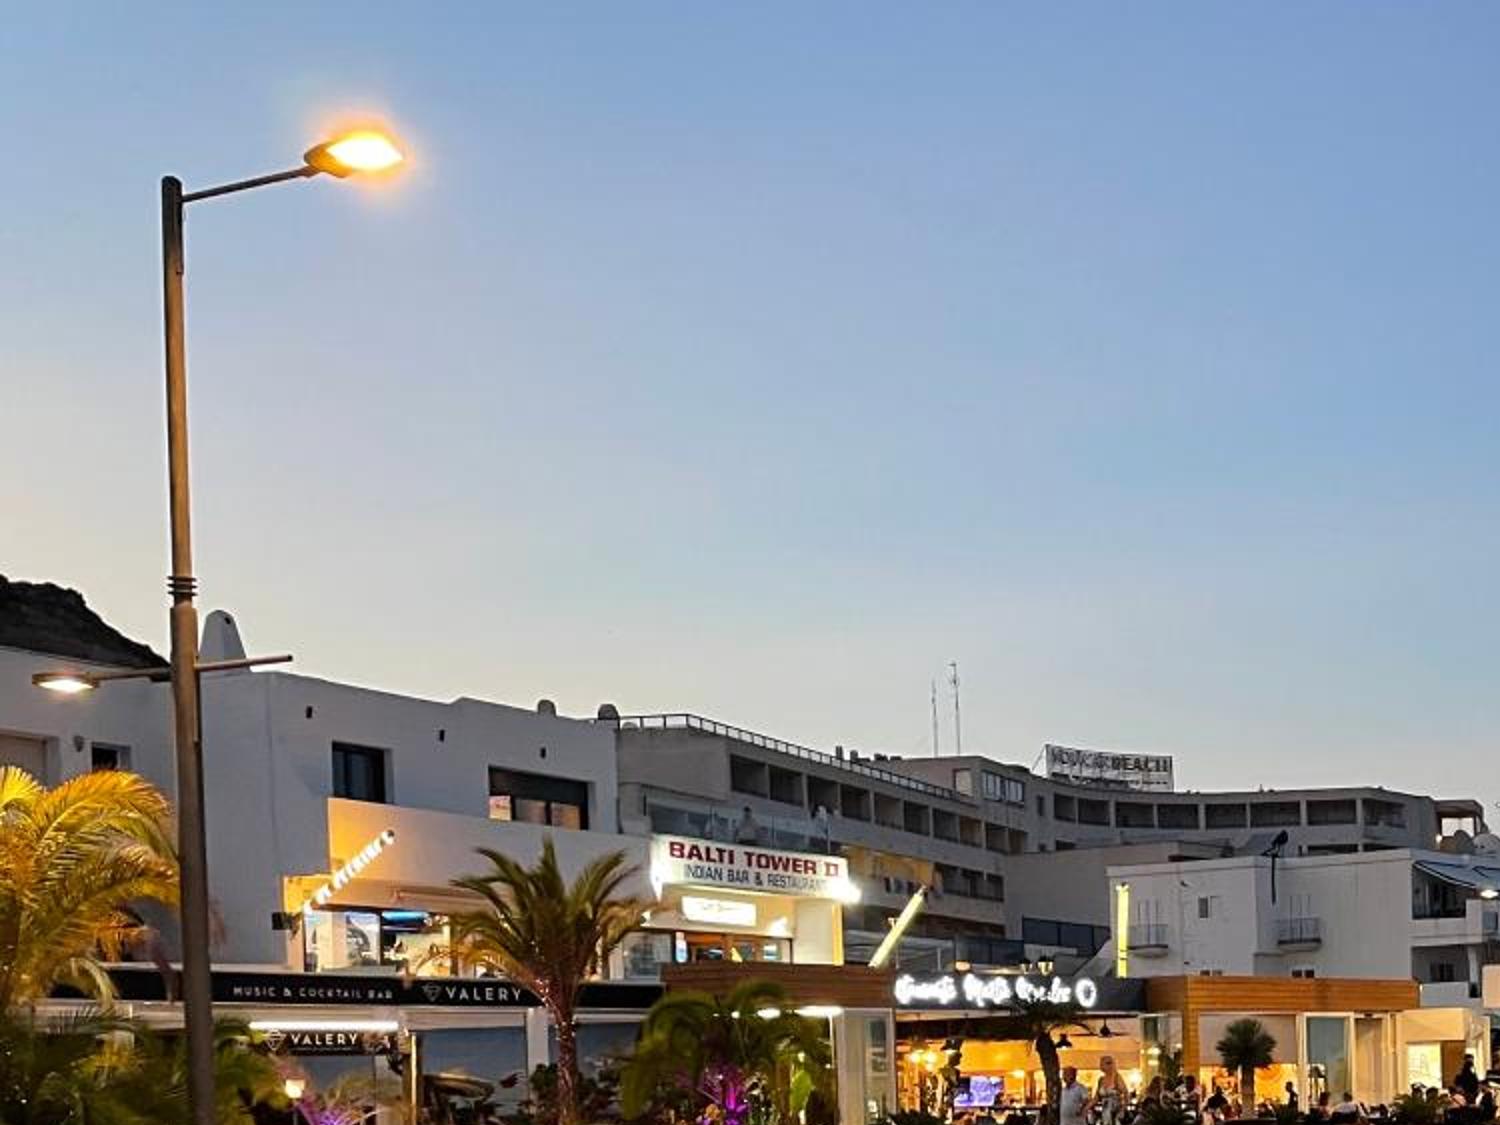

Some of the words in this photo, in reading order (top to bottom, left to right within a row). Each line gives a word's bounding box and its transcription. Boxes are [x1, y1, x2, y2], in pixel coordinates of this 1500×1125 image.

[669, 841, 735, 865] BALTI
[744, 851, 817, 875] TOWER
[685, 864, 723, 882] INDIAN
[727, 869, 749, 883] BAR
[755, 871, 764, 886] &
[233, 986, 276, 997] MUSIC
[283, 987, 291, 997] &
[299, 988, 361, 998] COCKTAIL
[368, 989, 393, 999] BAR
[445, 986, 522, 1001] VALERY
[291, 1033, 358, 1045] VALERY
